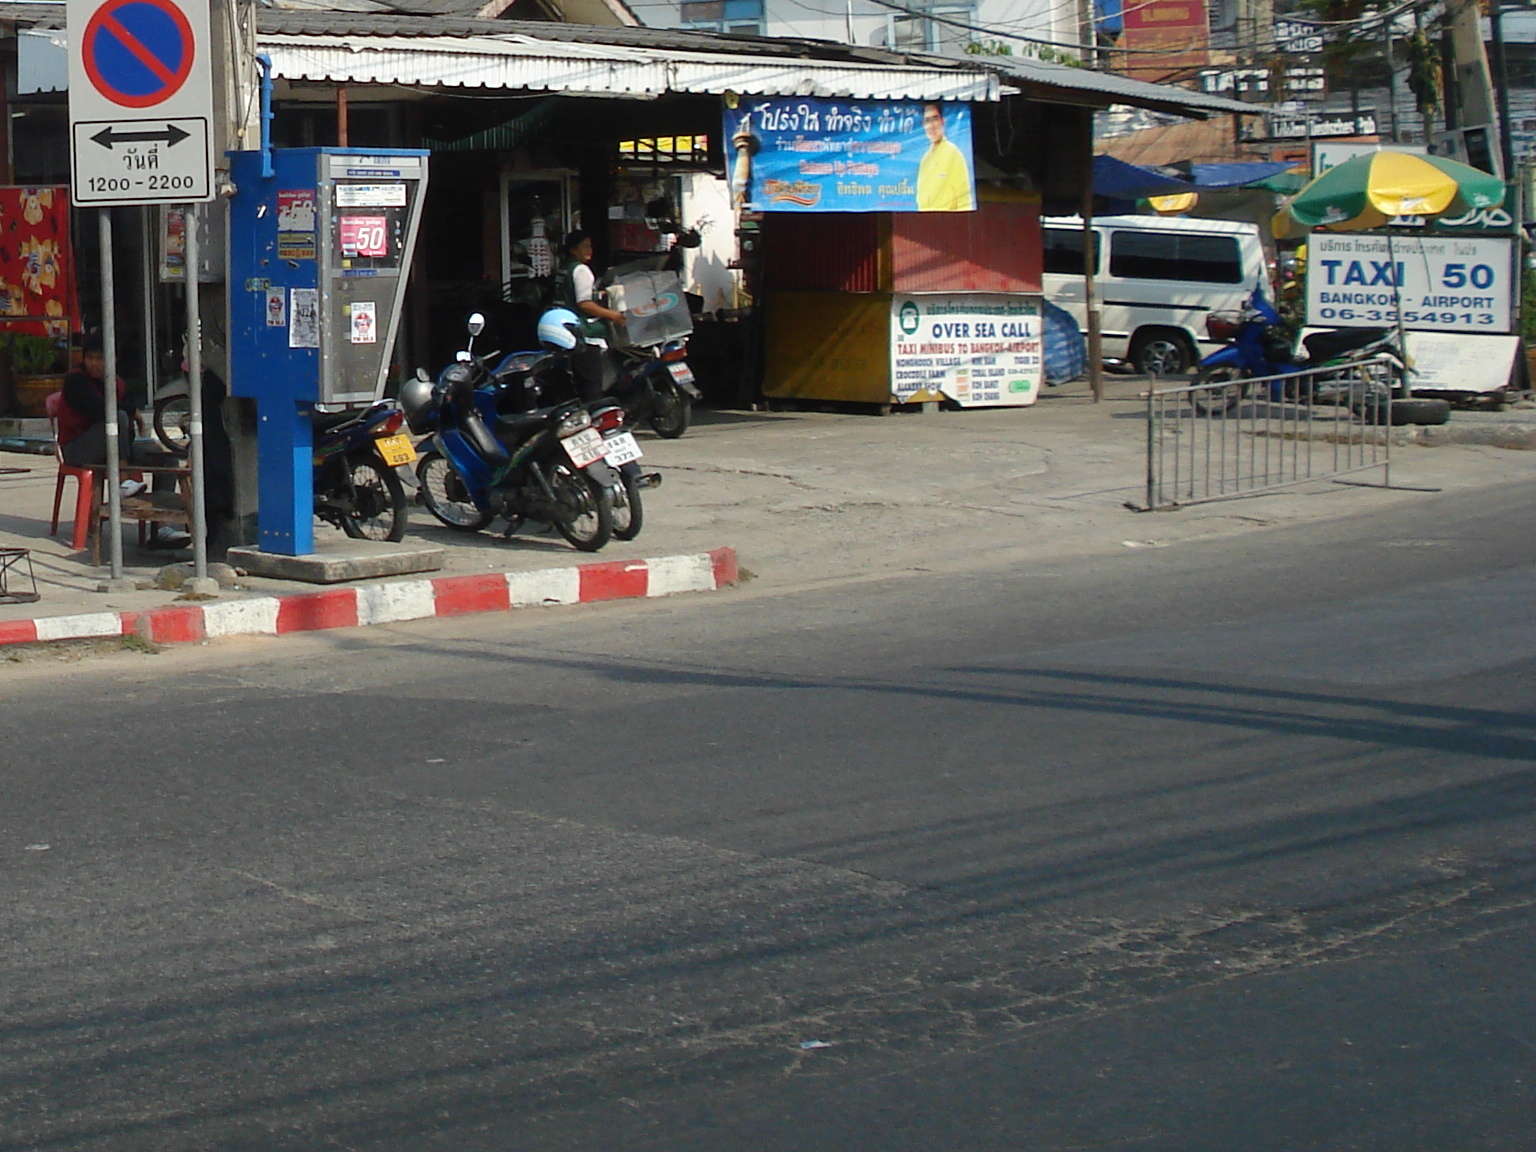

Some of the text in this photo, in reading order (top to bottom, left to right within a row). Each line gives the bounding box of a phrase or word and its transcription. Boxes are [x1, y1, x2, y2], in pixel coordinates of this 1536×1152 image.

[825, 105, 872, 133] ทำจริง
[123, 143, 159, 171] วันคี่
[88, 177, 130, 192] 1200
[148, 175, 194, 190] 2200
[356, 227, 384, 250] 50
[1320, 240, 1351, 253] บริการ
[1320, 259, 1495, 290] TAXI 50
[1421, 295, 1495, 309] AIRPORT
[1320, 308, 1495, 325] 06-3554913
[932, 322, 1031, 339] OVER SEA CALL
[898, 343, 917, 355] TAXI
[920, 342, 955, 355] MINIBUS
[958, 342, 968, 354] TO
[935, 356, 962, 366] VILLAGE
